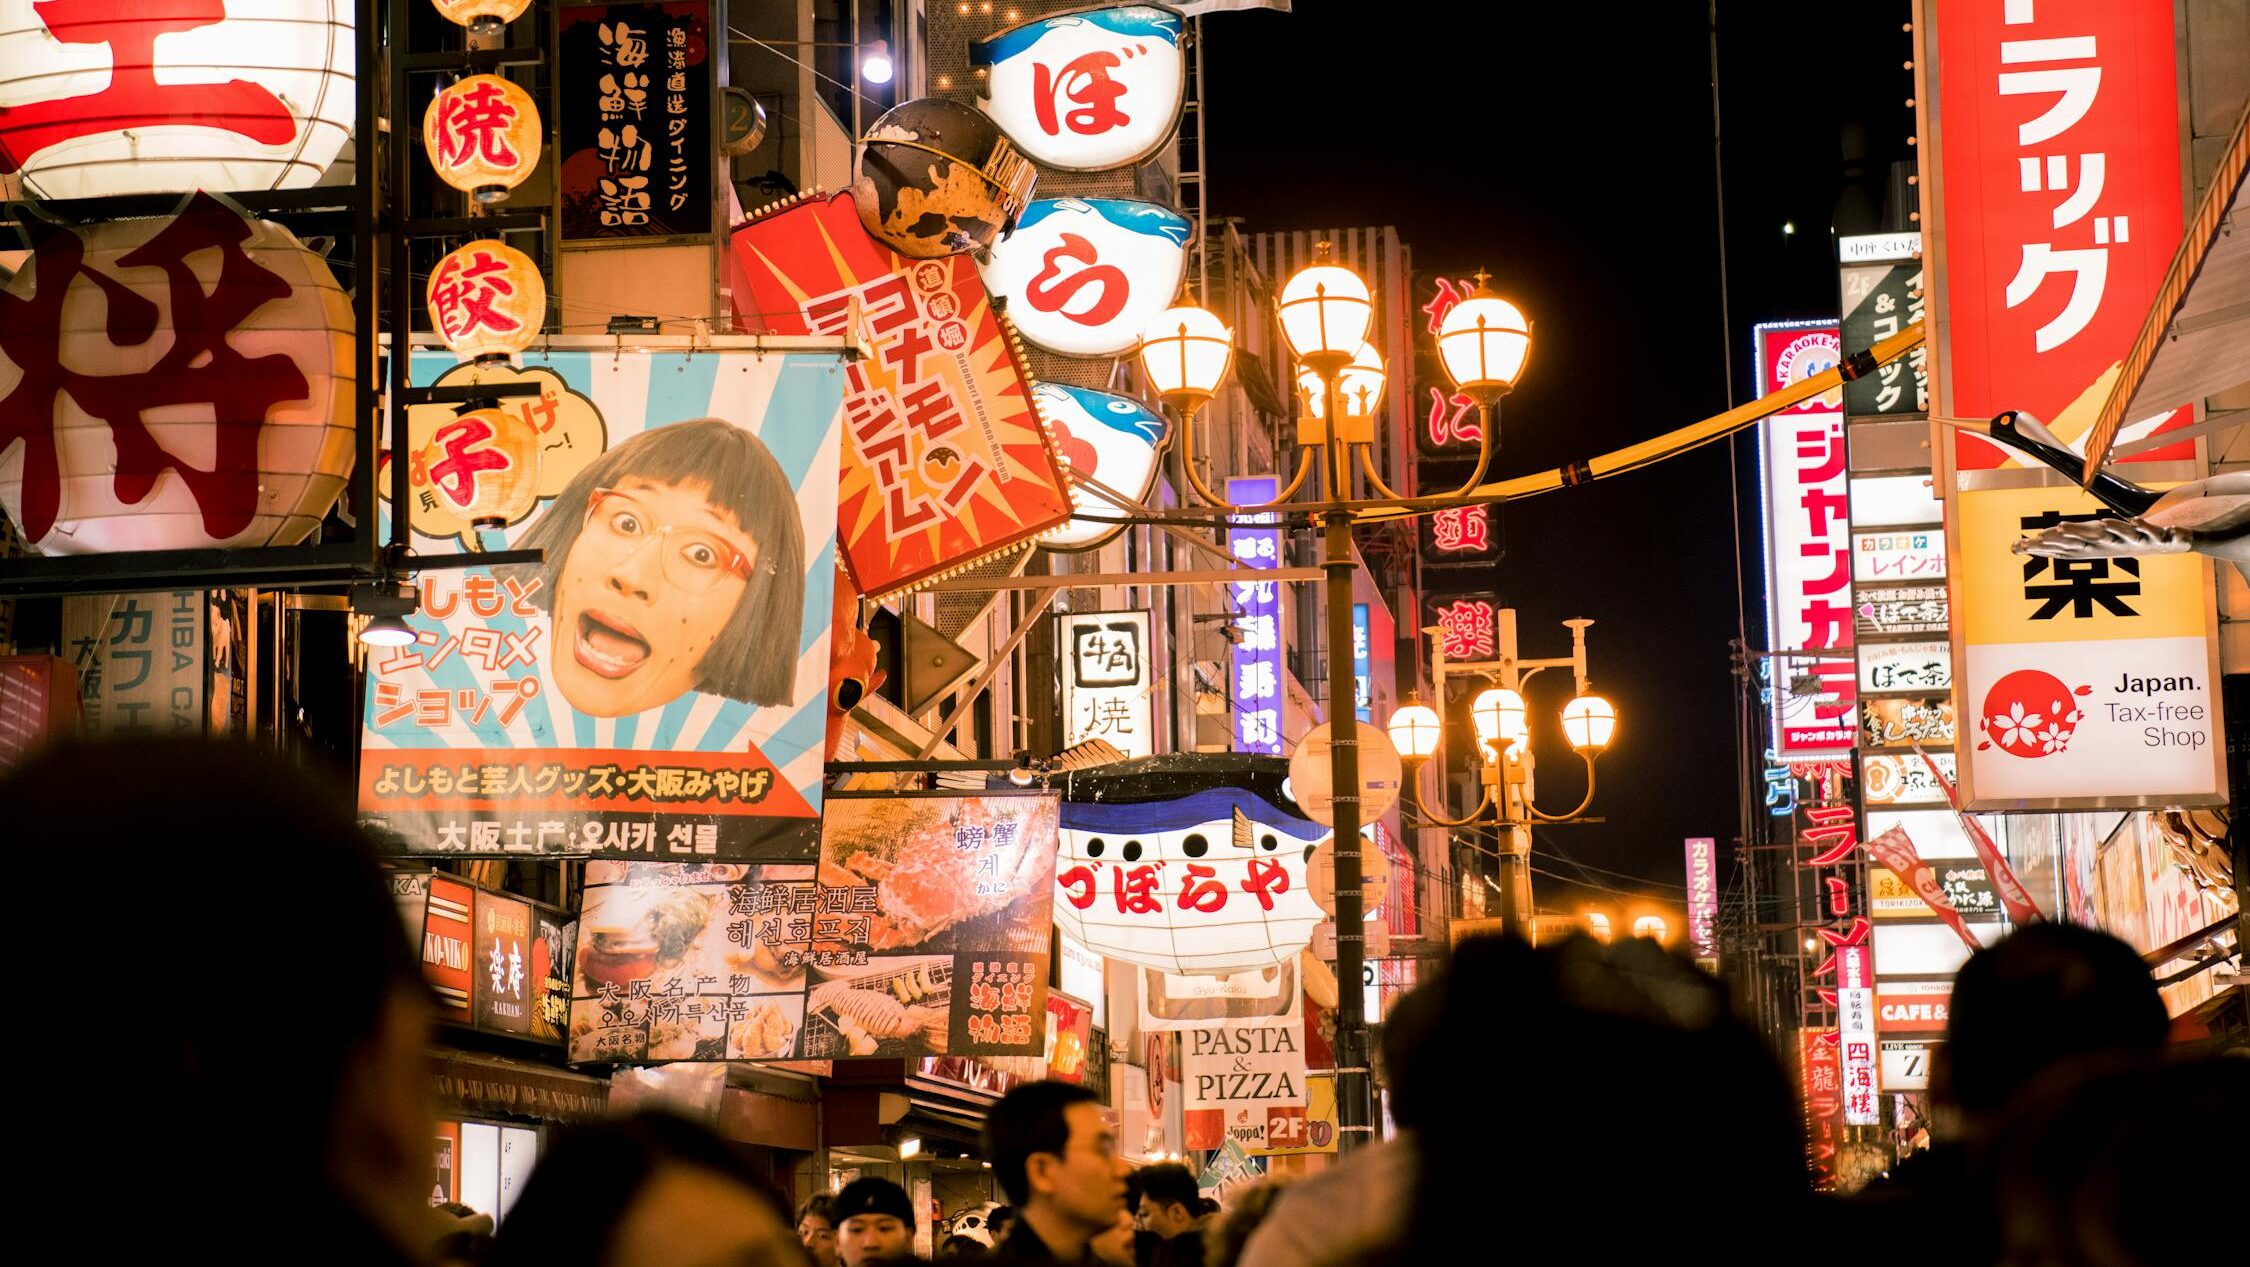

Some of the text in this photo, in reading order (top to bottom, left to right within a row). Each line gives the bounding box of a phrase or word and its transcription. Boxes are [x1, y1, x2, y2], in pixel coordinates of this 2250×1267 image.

[598, 22, 652, 226] 海鮮物語
[730, 103, 748, 132] 2
[1998, 0, 2130, 353] ラッグ
[1847, 272, 1870, 296] 2F
[1873, 293, 1902, 412] &コック
[412, 575, 544, 620] しもと
[2114, 673, 2202, 697] Japan.
[374, 676, 543, 728] ショップ
[2105, 701, 2205, 723] Tax-free
[1083, 696, 1133, 758] 焼
[2144, 727, 2207, 750] Shop
[667, 824, 719, 855] 선물
[729, 885, 879, 916] 海鮮居酒屋
[977, 882, 1008, 896] かに
[1057, 858, 1291, 914] づぼらや
[727, 917, 872, 949] 해선호프집
[784, 950, 869, 967] 海鮮居酒屋
[1881, 1004, 1932, 1021] CAFE
[1191, 1027, 1299, 1057] PASTA
[1233, 1056, 1253, 1073] &
[1195, 1072, 1298, 1101] PIZZA
[1270, 1115, 1304, 1139] 2F
